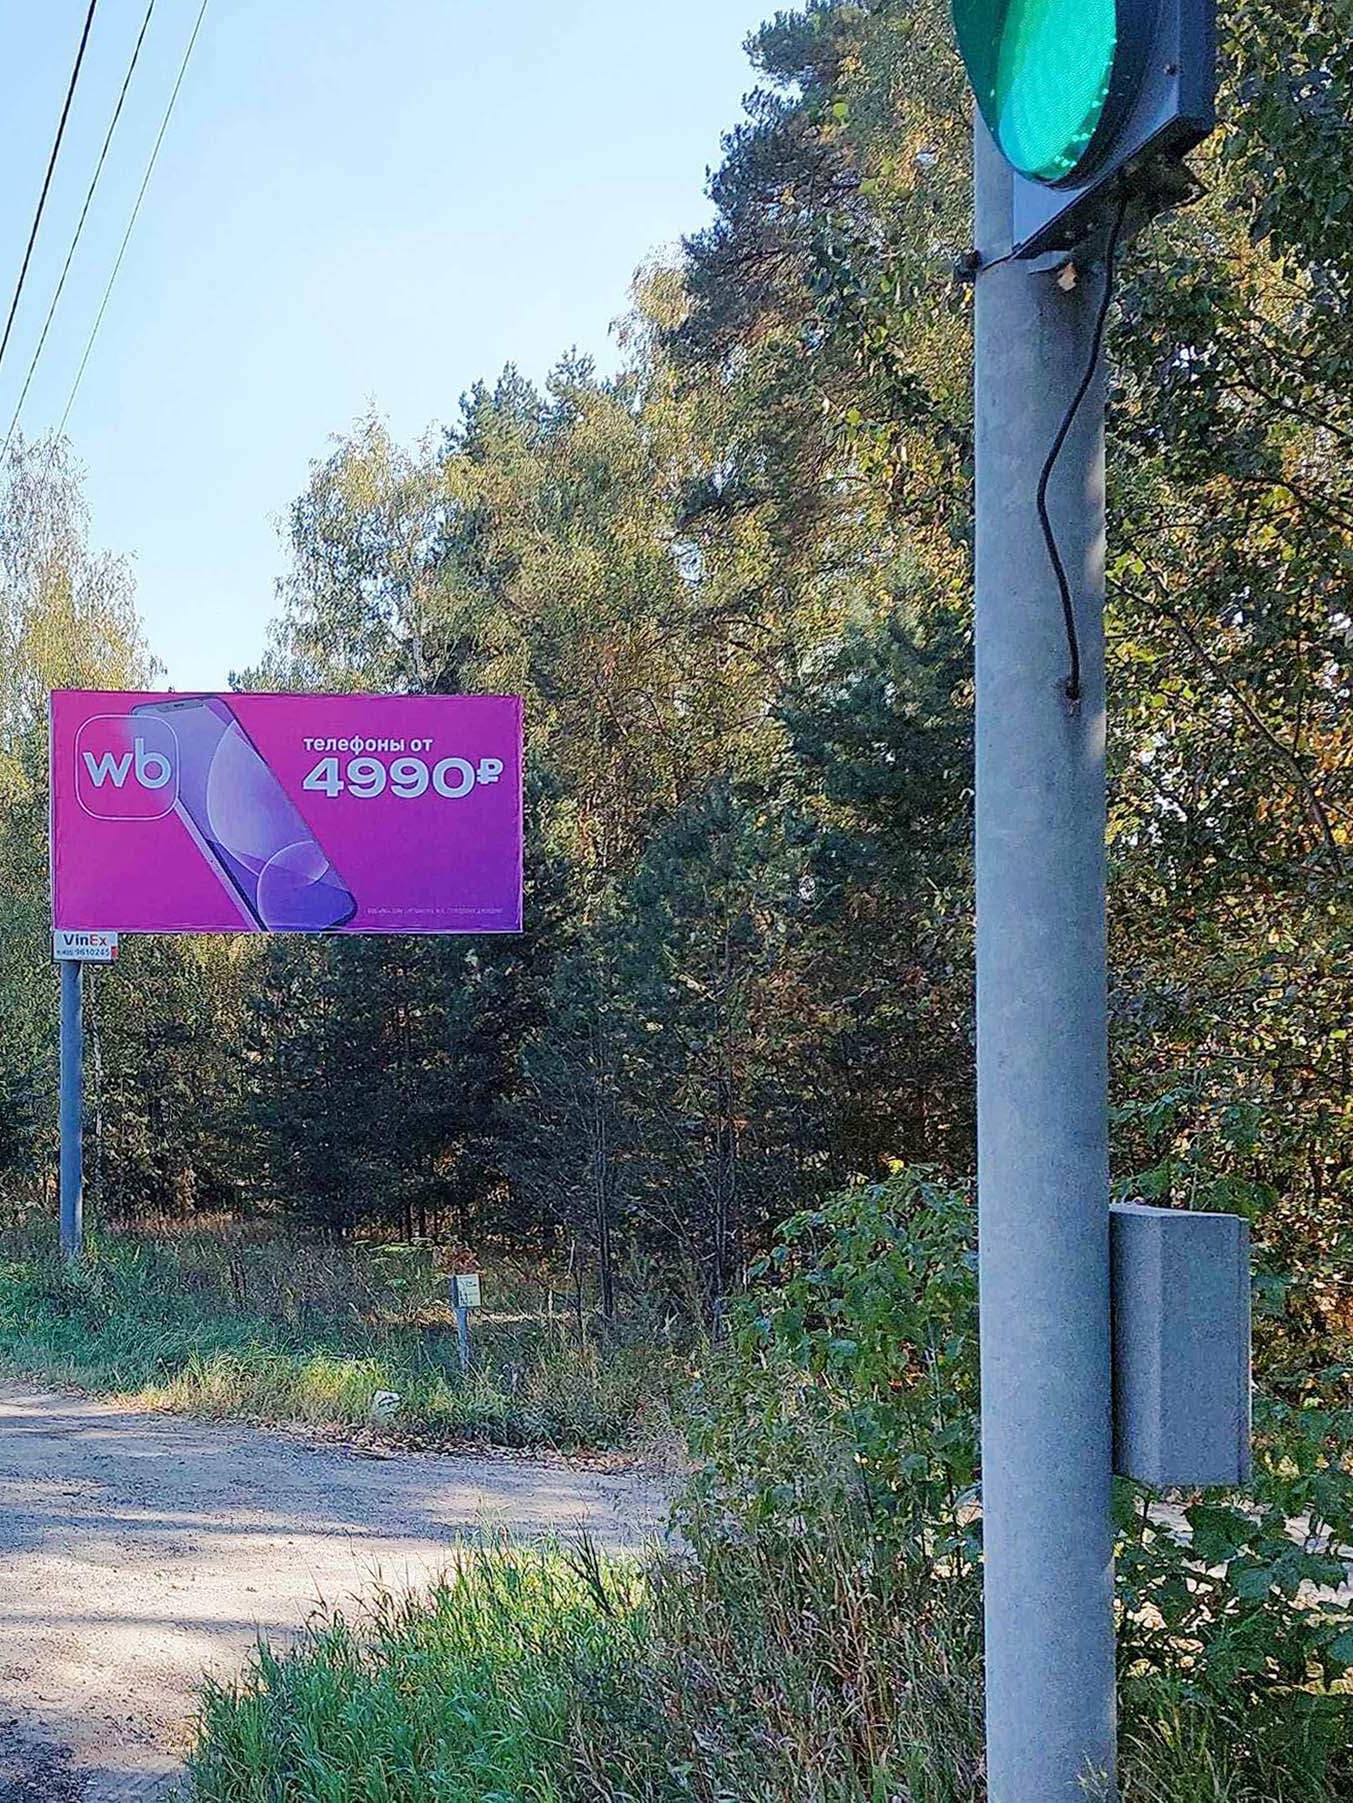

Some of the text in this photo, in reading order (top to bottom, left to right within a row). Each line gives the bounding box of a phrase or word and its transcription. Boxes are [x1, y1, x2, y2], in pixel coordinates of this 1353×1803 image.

[303, 735, 433, 755] телефоны от
[82, 738, 172, 789] wb
[63, 933, 107, 946] VinEx
